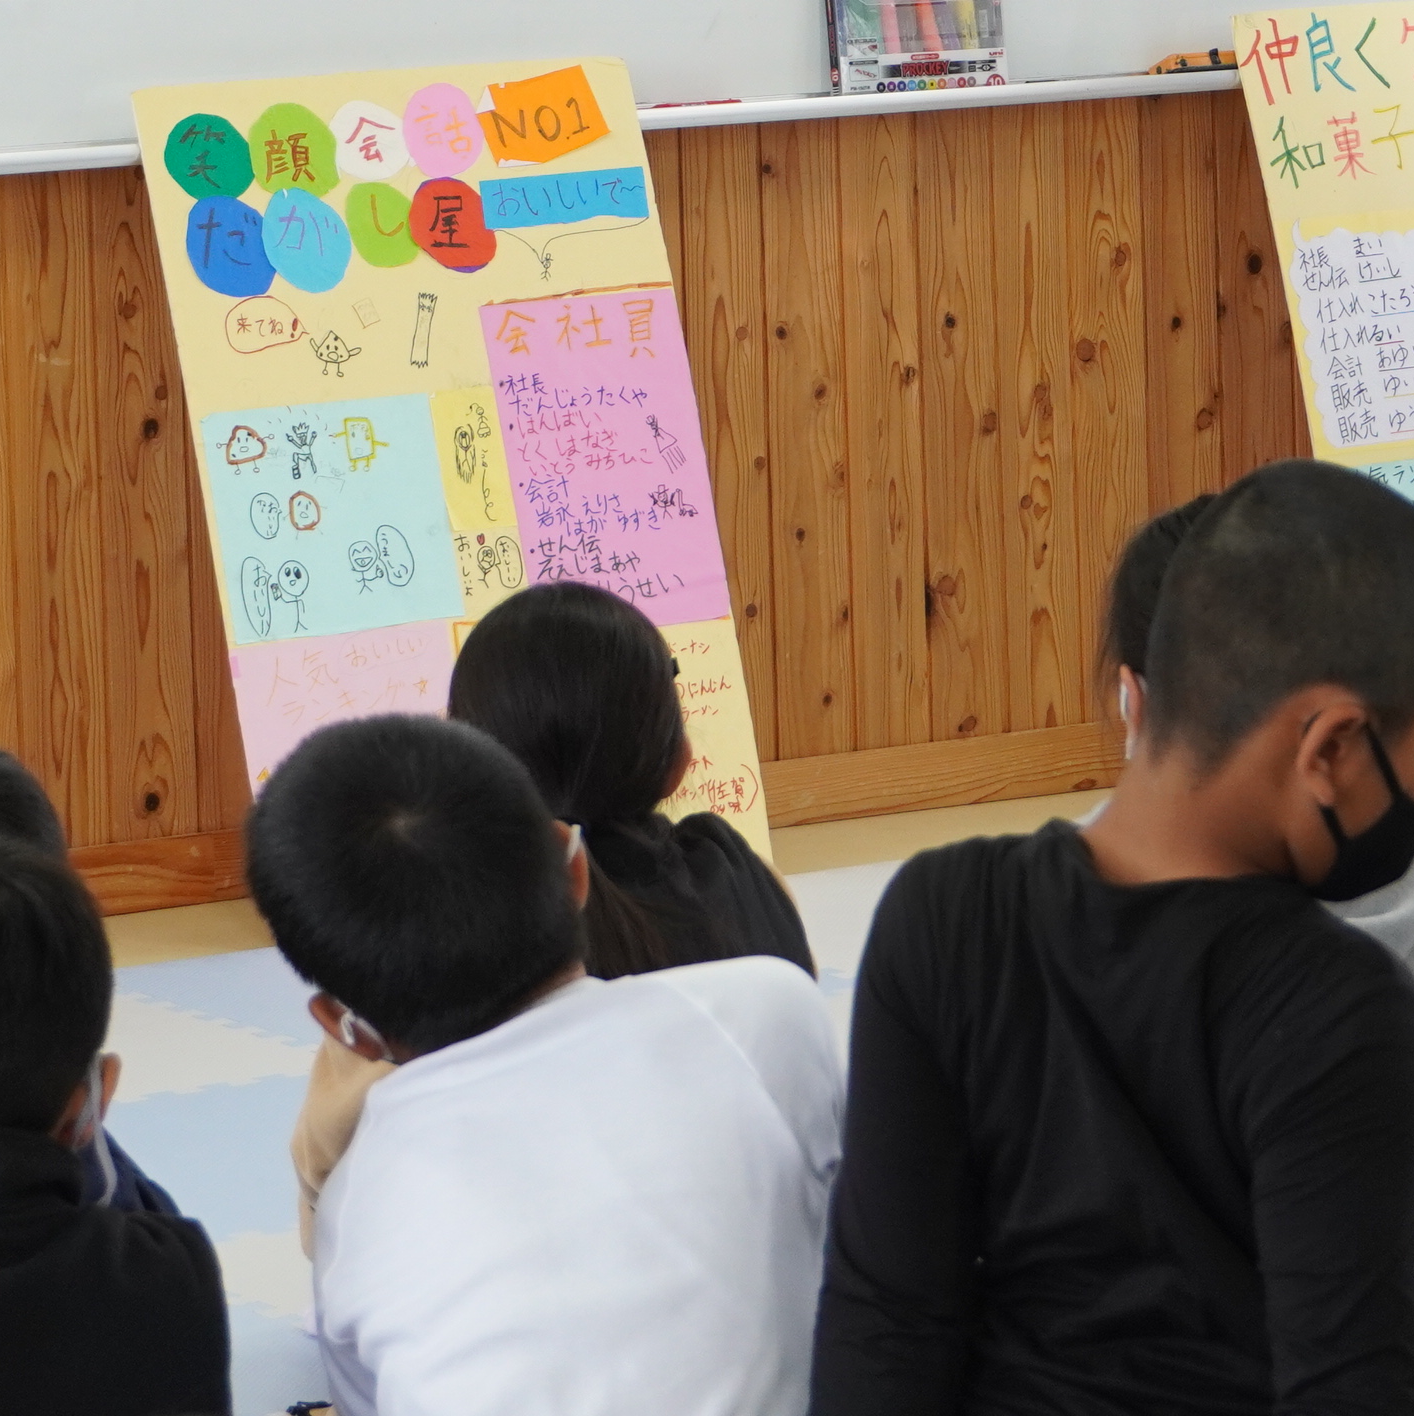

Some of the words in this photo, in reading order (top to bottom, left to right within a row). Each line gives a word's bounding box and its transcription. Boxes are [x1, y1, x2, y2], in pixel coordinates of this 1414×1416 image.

[902, 61, 950, 78] PROCKEY
[179, 104, 473, 189] 笑顔会話
[197, 193, 469, 269] だがし屋
[1298, 246, 1331, 272] 社長
[1303, 266, 1350, 292] せん伝
[1317, 292, 1365, 323] 仕入れ
[495, 298, 656, 359] 会社員
[1320, 325, 1374, 354] 仕入れ
[1327, 355, 1363, 380] 会計
[504, 373, 548, 396] 社長
[1331, 381, 1372, 413] 販売
[1337, 408, 1379, 445] 販売
[524, 475, 569, 503] 会計
[537, 535, 602, 557] せん伝
[266, 649, 340, 707] 人気
